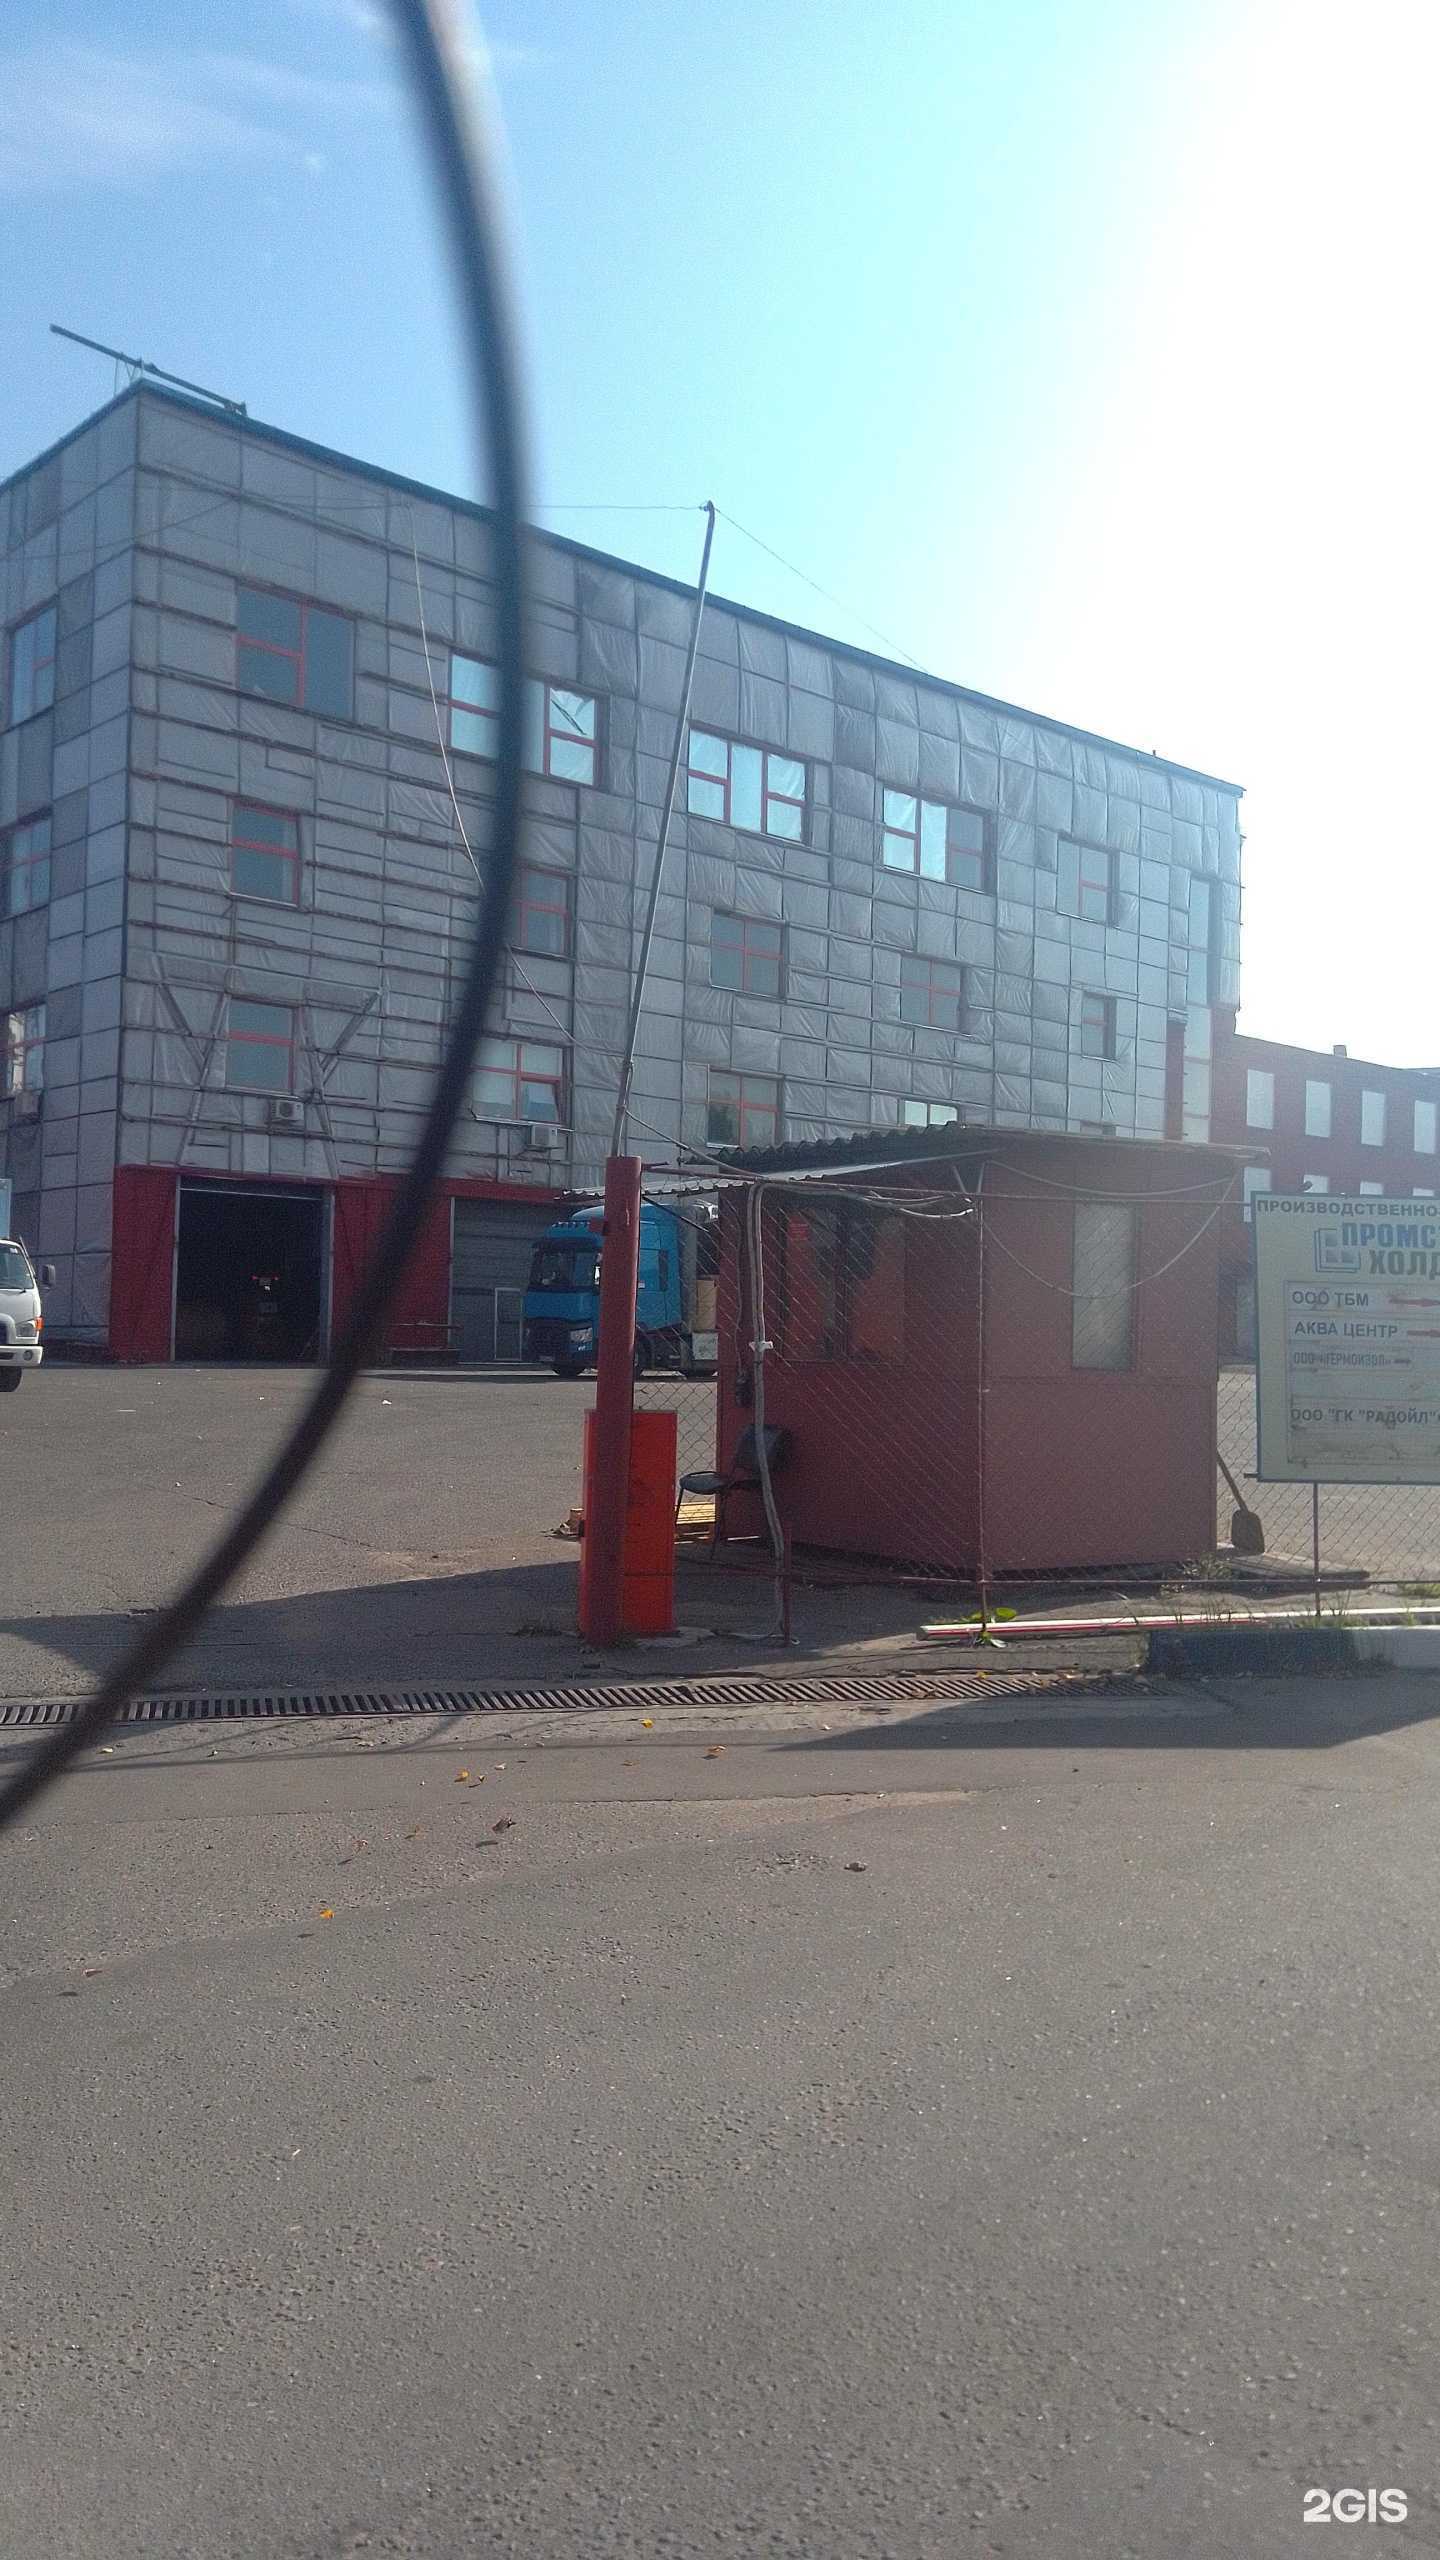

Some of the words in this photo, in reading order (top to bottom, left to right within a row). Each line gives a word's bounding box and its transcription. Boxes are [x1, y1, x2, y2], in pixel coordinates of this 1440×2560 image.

[1342, 1223, 1440, 1249] ПРОМС
[1292, 1290, 1329, 1306] ООО
[1334, 1292, 1369, 1307] ТБМ
[1294, 1321, 1338, 1335] АКВА
[1343, 1323, 1398, 1338] ЦЕНТР
[1290, 1409, 1323, 1421] ООО
